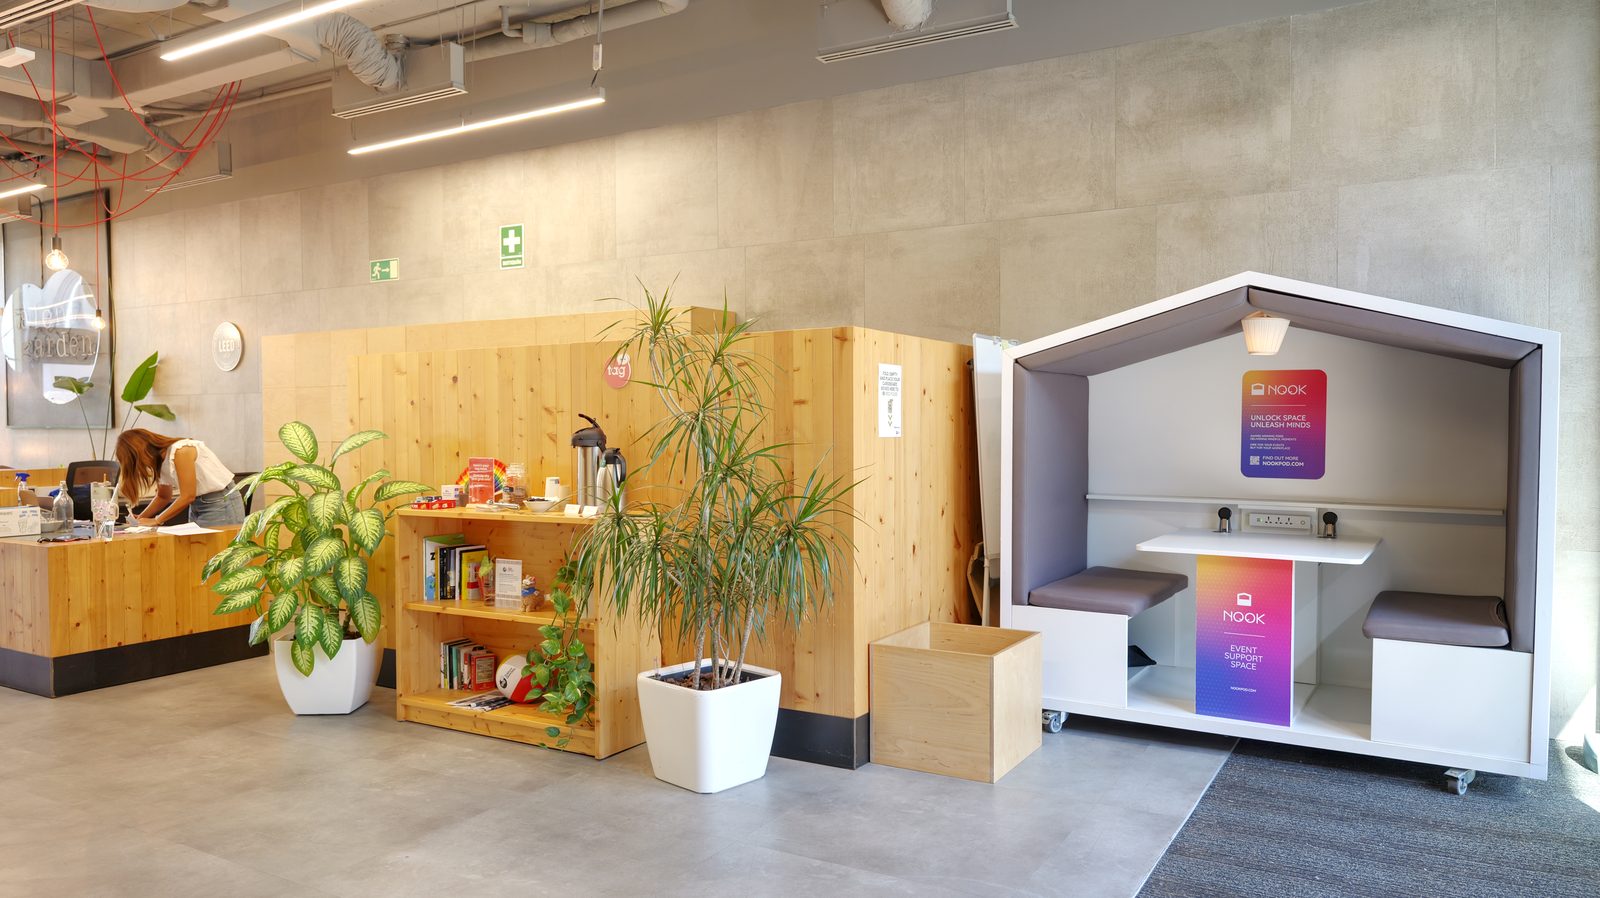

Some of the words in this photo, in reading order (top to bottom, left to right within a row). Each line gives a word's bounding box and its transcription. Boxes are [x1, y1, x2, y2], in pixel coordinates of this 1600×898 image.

[218, 338, 235, 353] LEED
[607, 364, 626, 378] tag
[1267, 384, 1307, 395] NOOK
[1223, 609, 1266, 625] NOOK
[1230, 644, 1257, 654] EVENT
[1224, 652, 1263, 663] SUPPORT
[1230, 660, 1257, 671] SPACE
